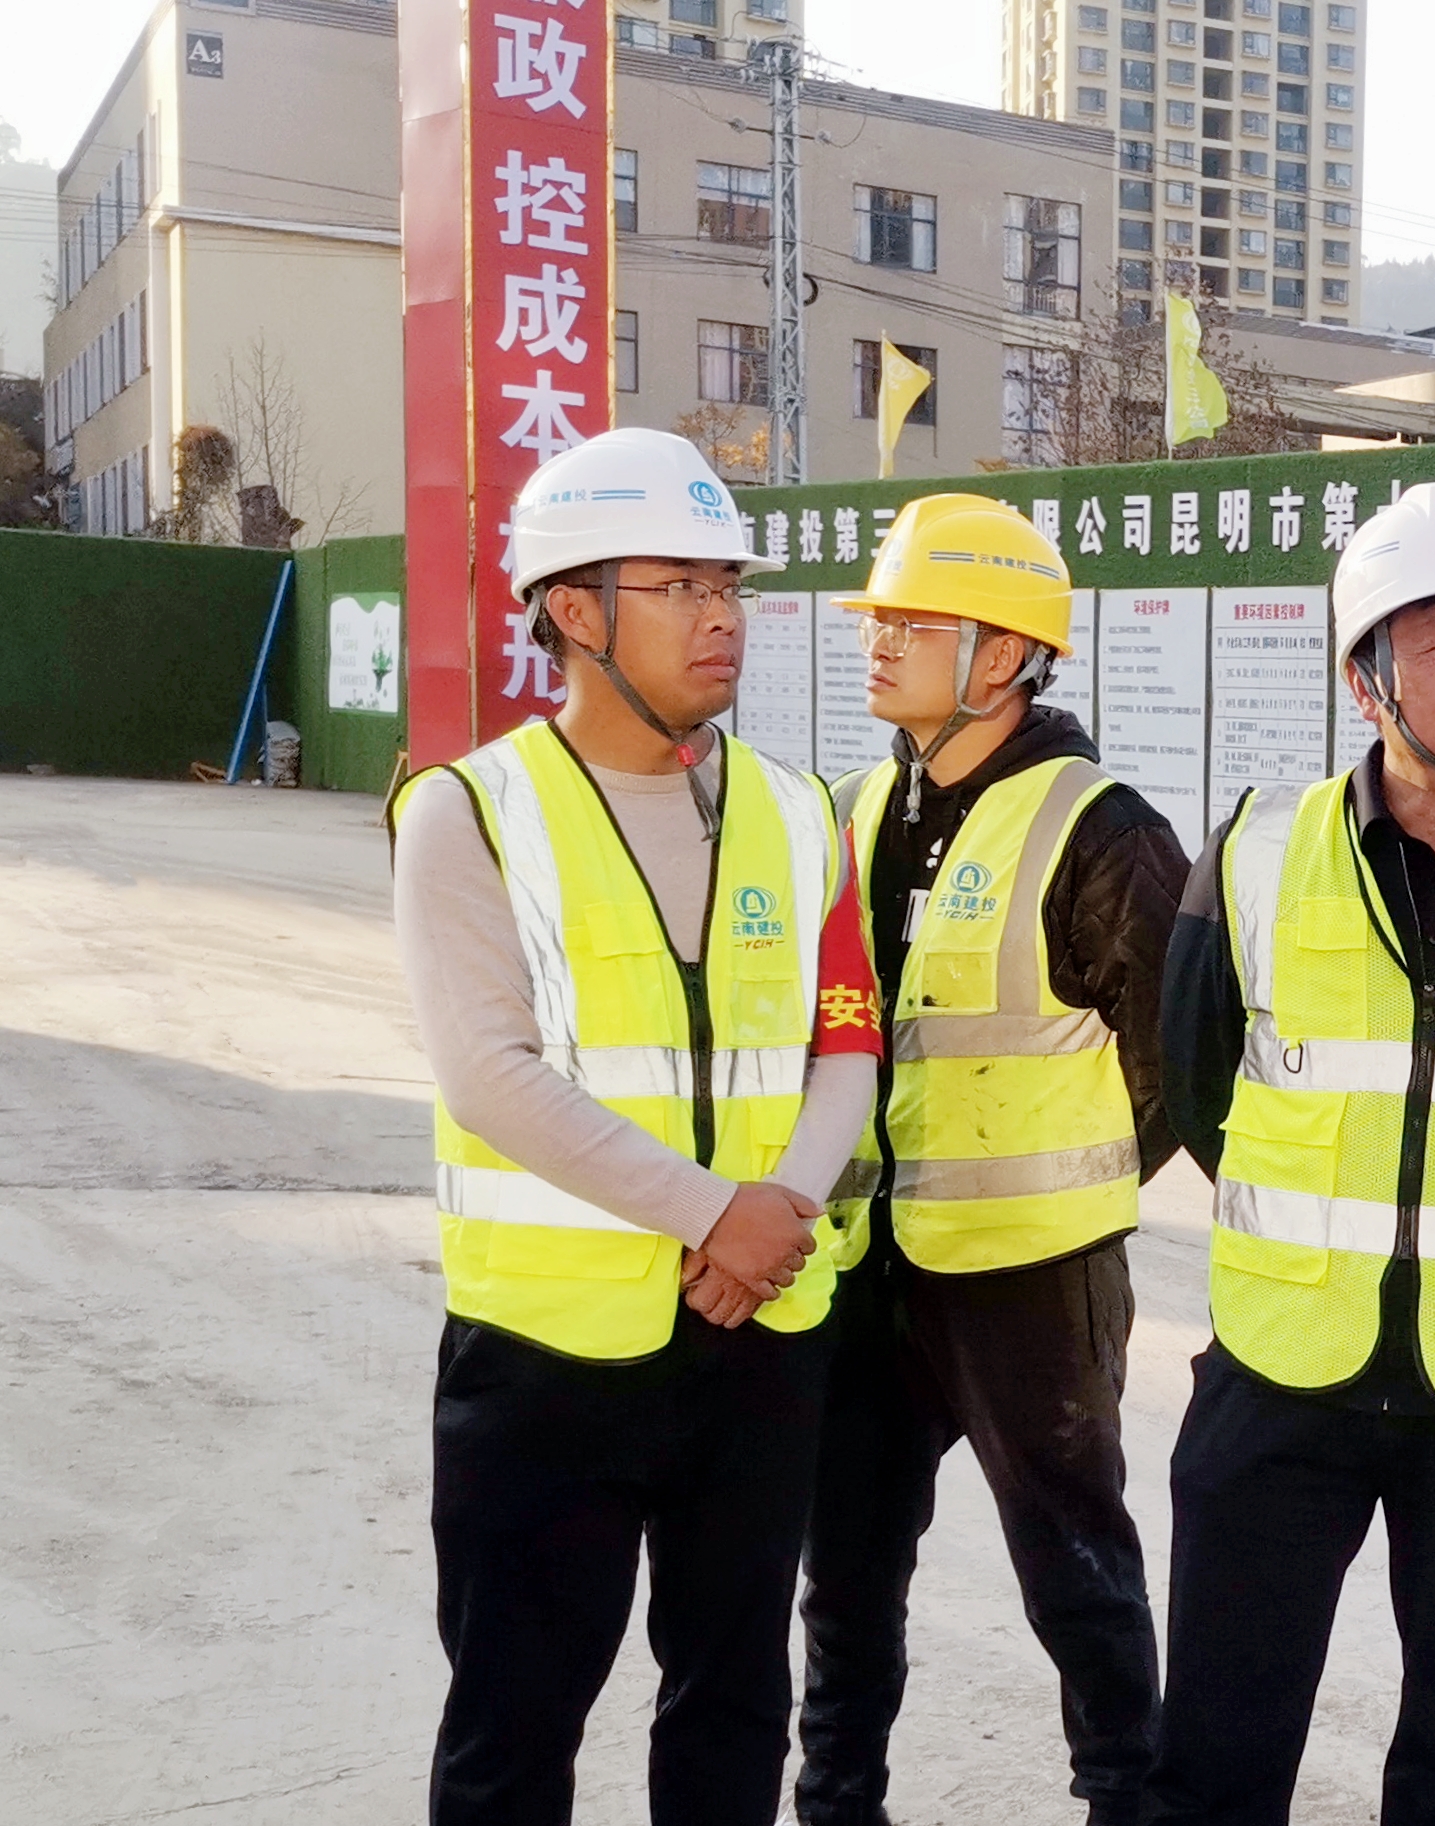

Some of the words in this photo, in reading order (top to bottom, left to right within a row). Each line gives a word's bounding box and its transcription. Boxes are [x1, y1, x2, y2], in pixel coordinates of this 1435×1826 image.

[188, 39, 221, 65] A3
[943, 910, 979, 921] YCIH
[732, 920, 783, 937] 云南建投
[744, 938, 773, 950] YCIH
